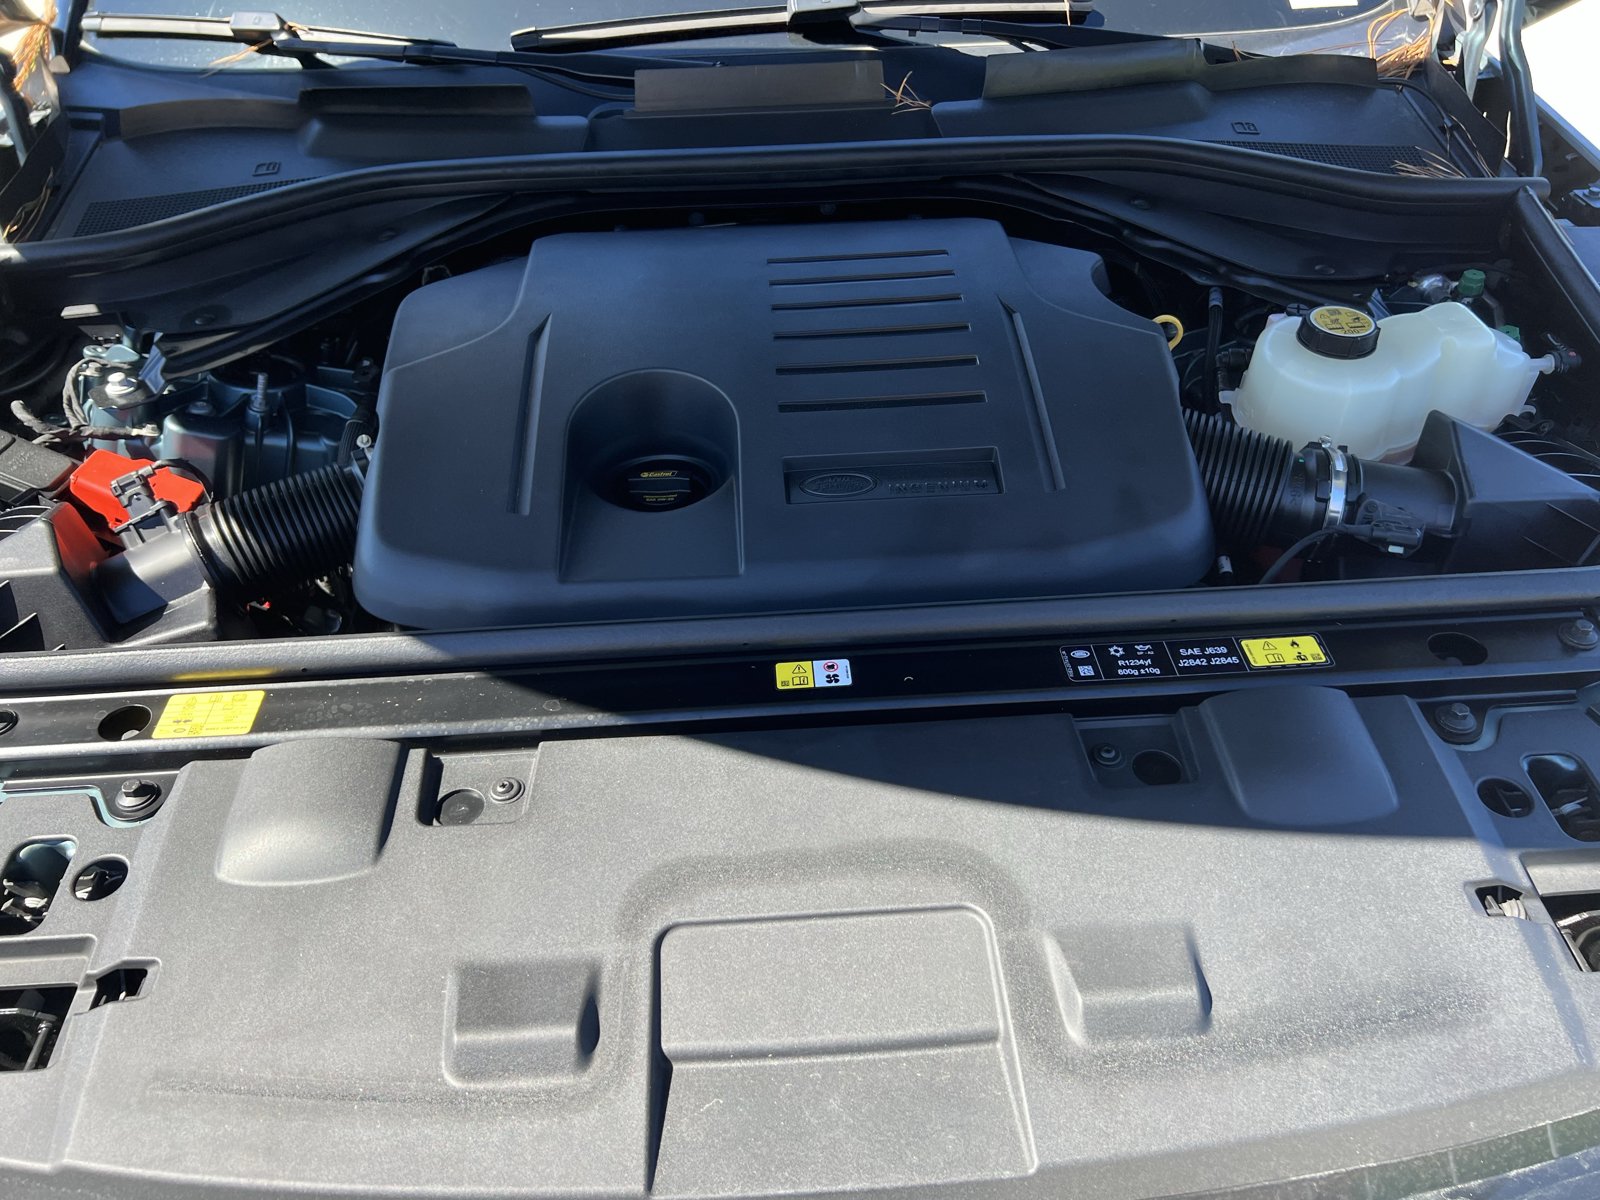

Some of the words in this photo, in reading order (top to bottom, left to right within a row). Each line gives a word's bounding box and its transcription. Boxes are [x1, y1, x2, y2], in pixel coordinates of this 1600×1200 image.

[888, 479, 988, 495] INGENIUM
[1179, 647, 1203, 656] SAE
[1204, 646, 1228, 655] J639
[1117, 658, 1152, 667] R1234yf
[1178, 658, 1208, 667] J2842
[1210, 656, 1240, 665] J2845
